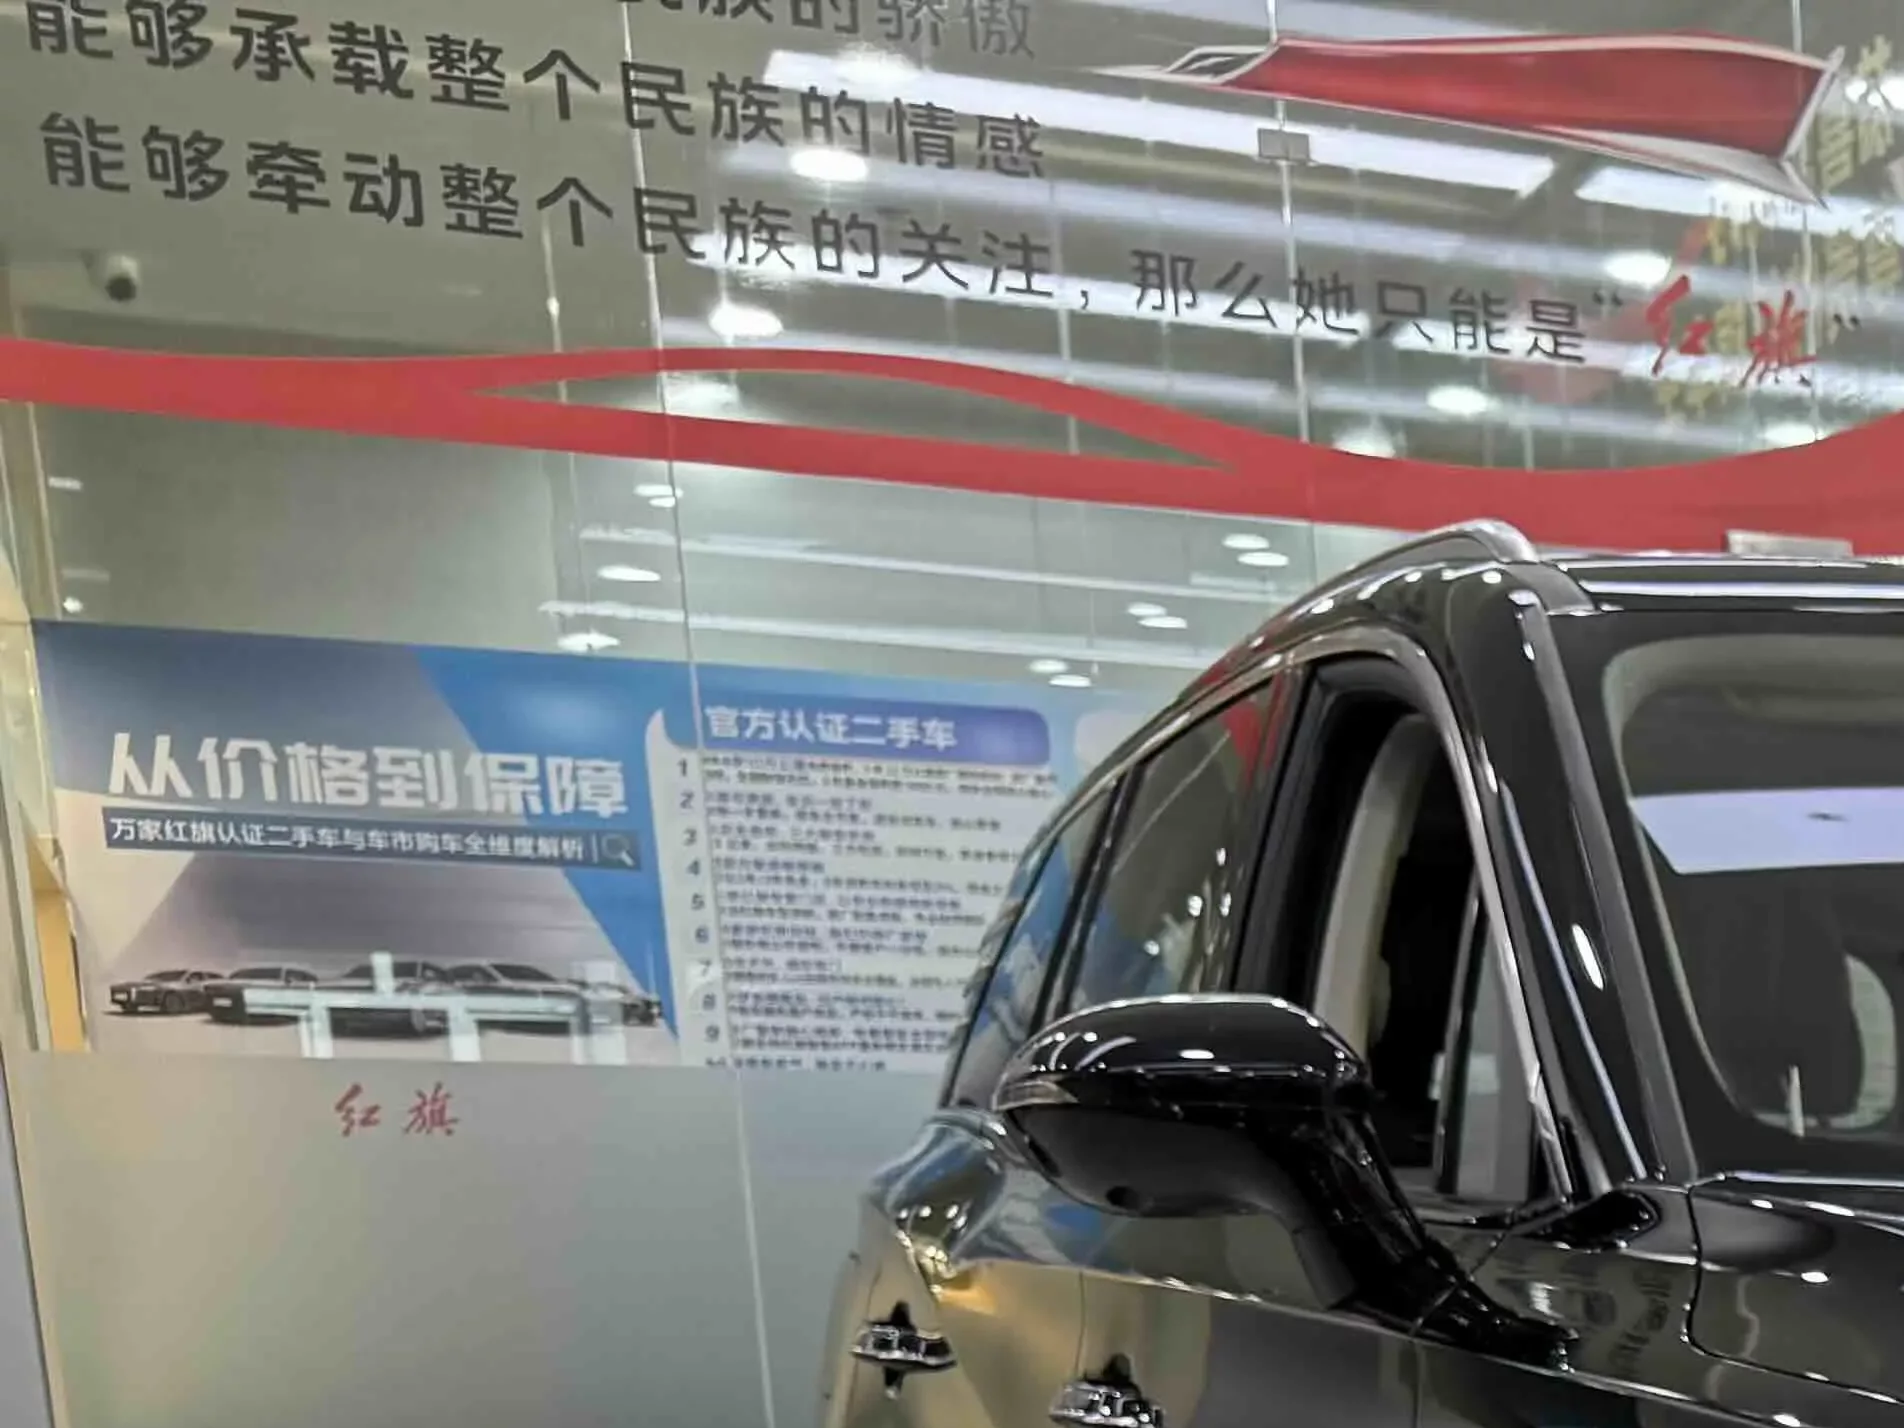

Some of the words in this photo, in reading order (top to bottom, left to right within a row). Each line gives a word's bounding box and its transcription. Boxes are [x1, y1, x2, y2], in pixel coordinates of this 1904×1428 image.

[26, 0, 1046, 179] 能够承载整个民族的情感
[704, 704, 958, 750] 官方认证二手车
[107, 731, 628, 819] 从价格到保障
[335, 1081, 461, 1136] 红旗
